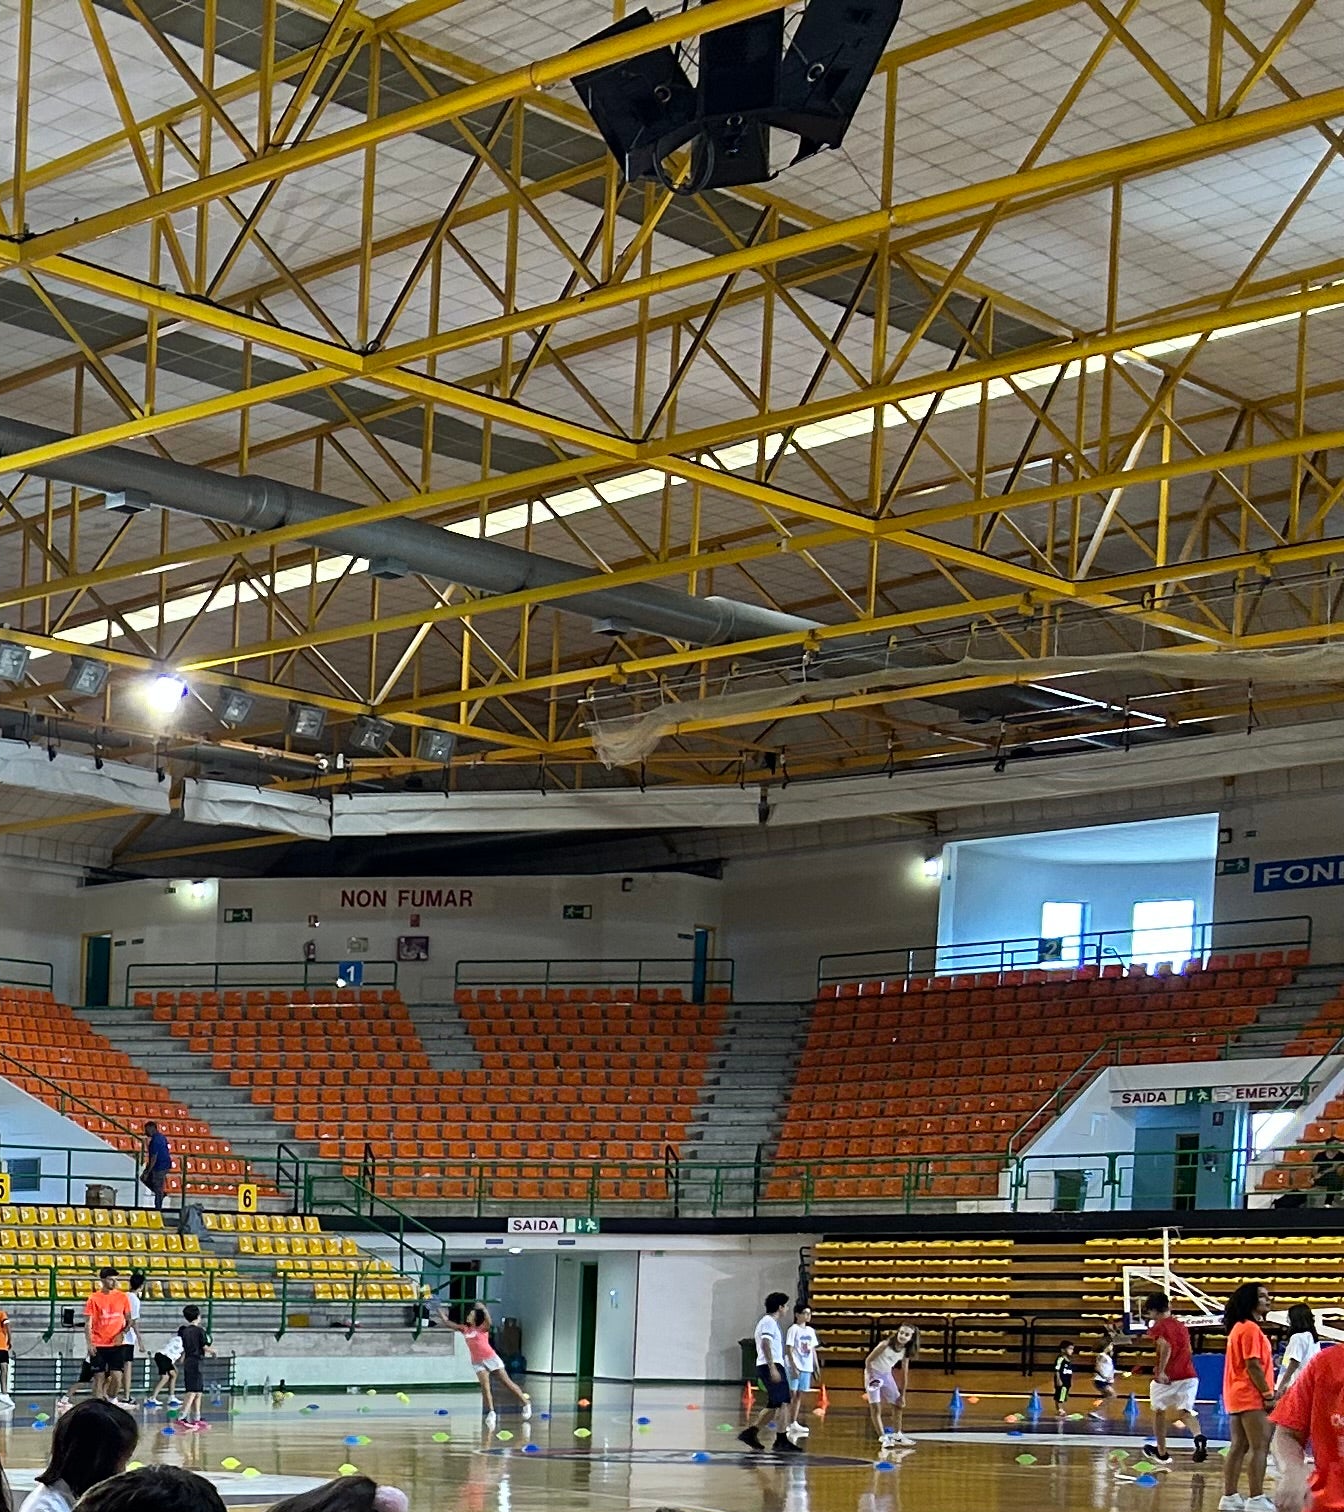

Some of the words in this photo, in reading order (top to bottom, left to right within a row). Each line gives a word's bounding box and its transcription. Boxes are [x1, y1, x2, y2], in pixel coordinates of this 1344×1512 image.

[1262, 861, 1344, 887] FON
[341, 890, 387, 907] NON
[398, 890, 473, 907] FUMAR
[346, 965, 355, 982] 1
[1121, 1091, 1167, 1104] SAIDA
[243, 1189, 252, 1208] 6
[513, 1220, 558, 1231] SAIDA
